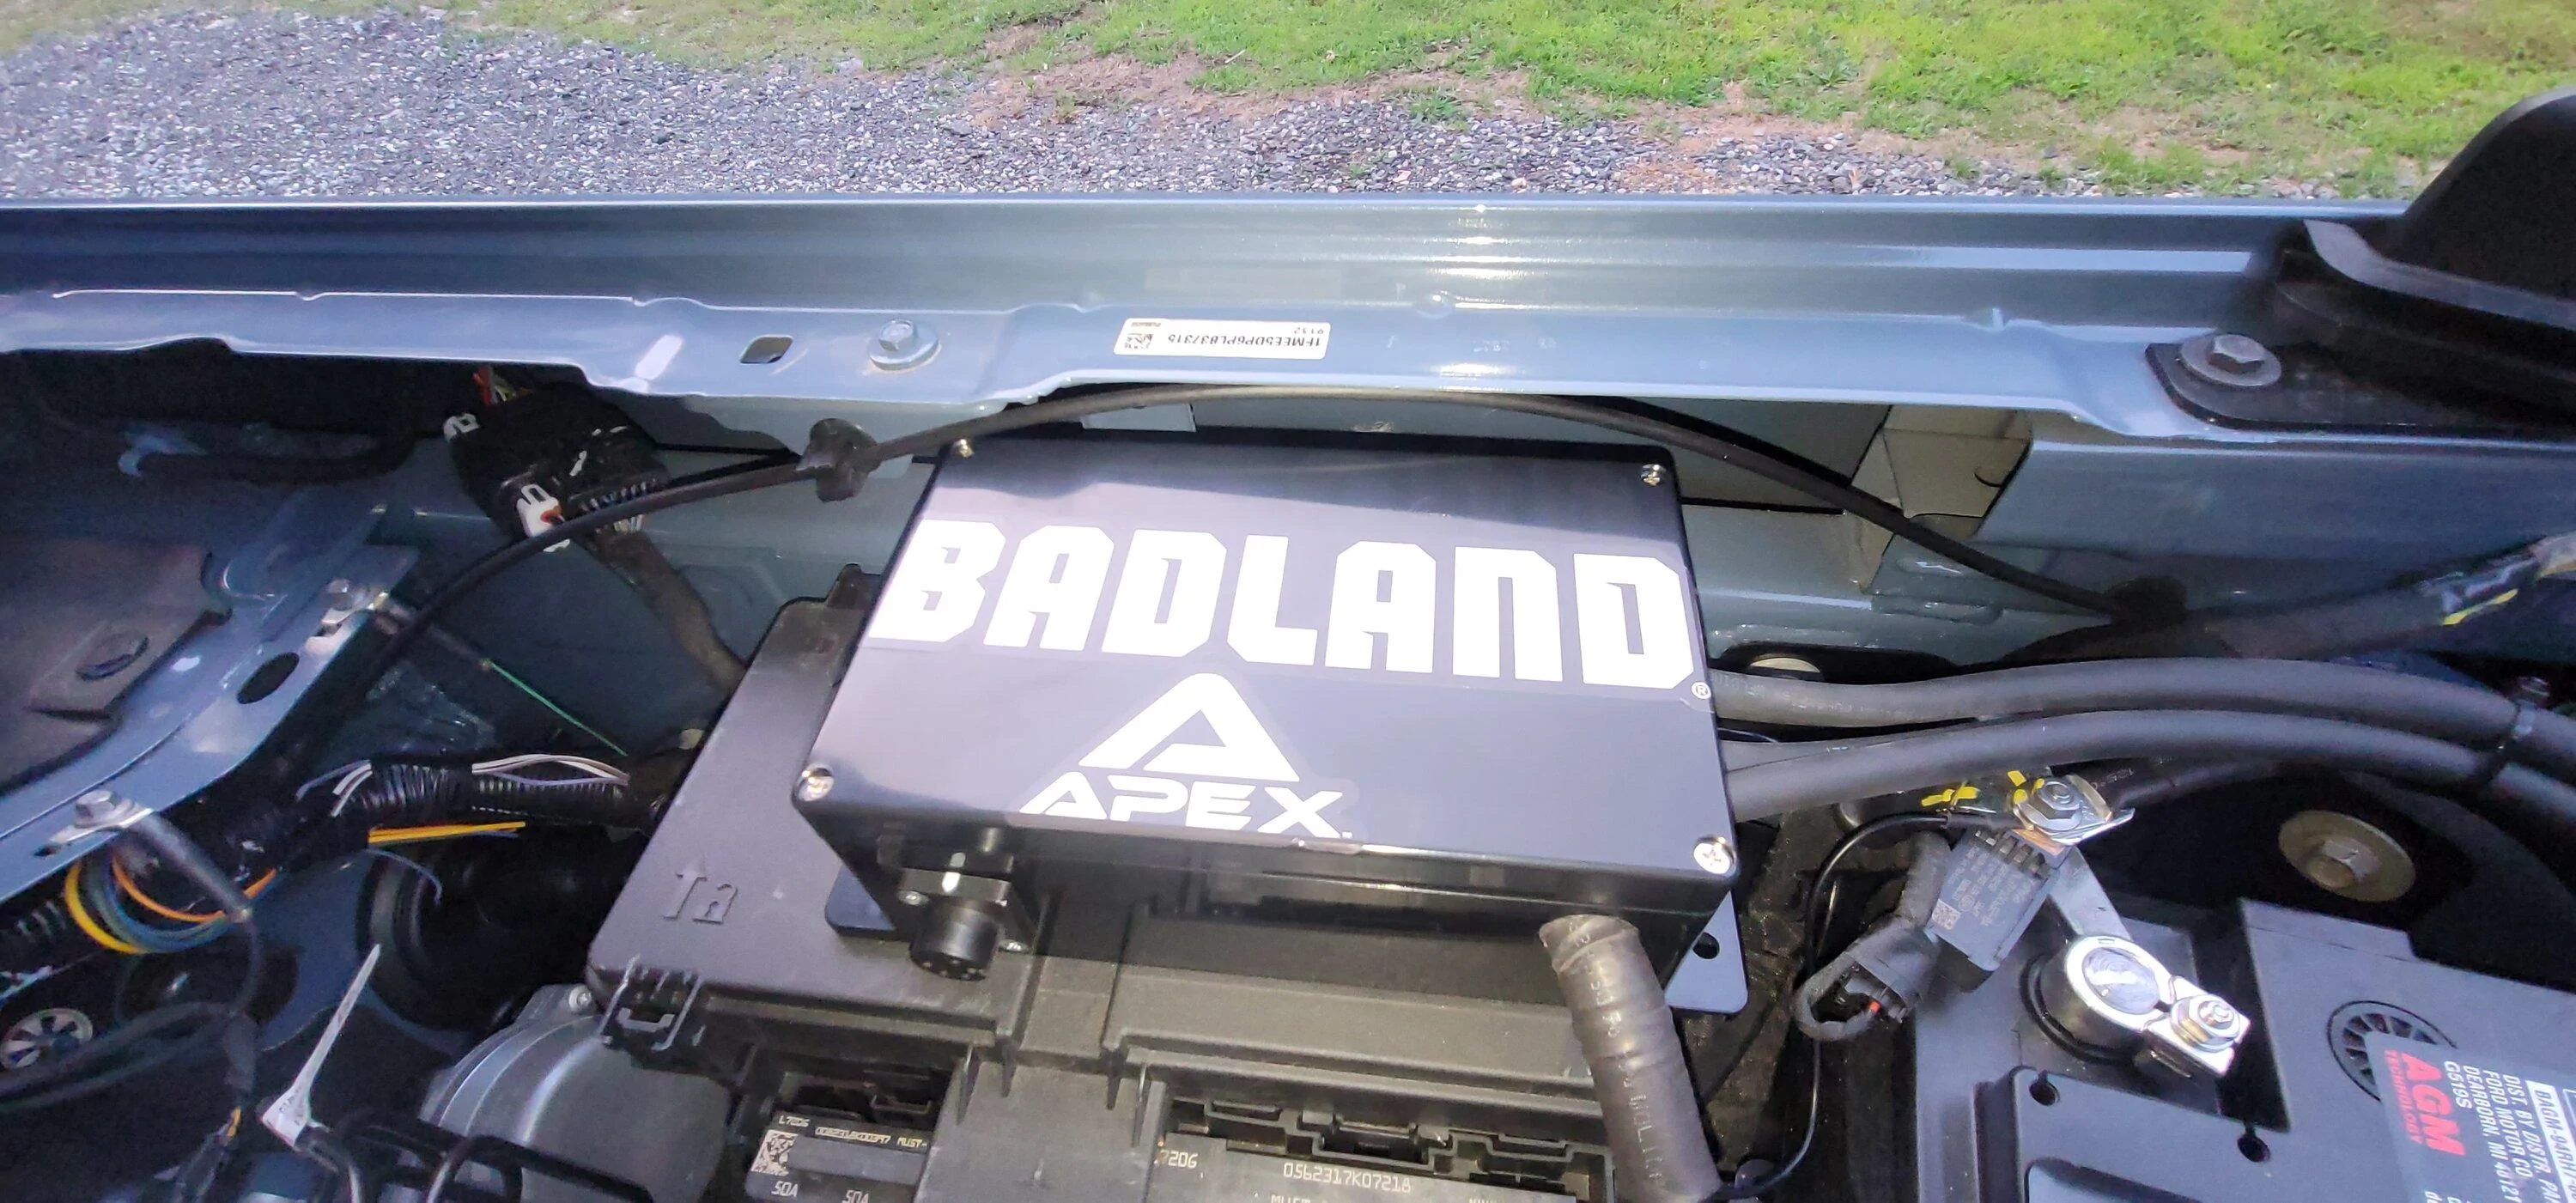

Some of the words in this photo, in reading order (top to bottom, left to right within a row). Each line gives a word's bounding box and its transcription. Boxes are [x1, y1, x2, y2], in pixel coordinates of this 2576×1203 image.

[868, 519, 1694, 689] BADLAND
[1019, 771, 1341, 839] APEX
[2384, 1049, 2423, 1144] TECHNOLOGY
[2402, 1053, 2466, 1156] AGM
[2463, 1065, 2500, 1137] DEARBORN,
[2488, 1141, 2509, 1160] MI
[2482, 1069, 2508, 1105] FORD
[2502, 1074, 2528, 1106] DIST.
[2494, 1107, 2526, 1156] MOTOR
[2514, 1109, 2537, 1129] BY
[2522, 1130, 2552, 1174] DISTR.
